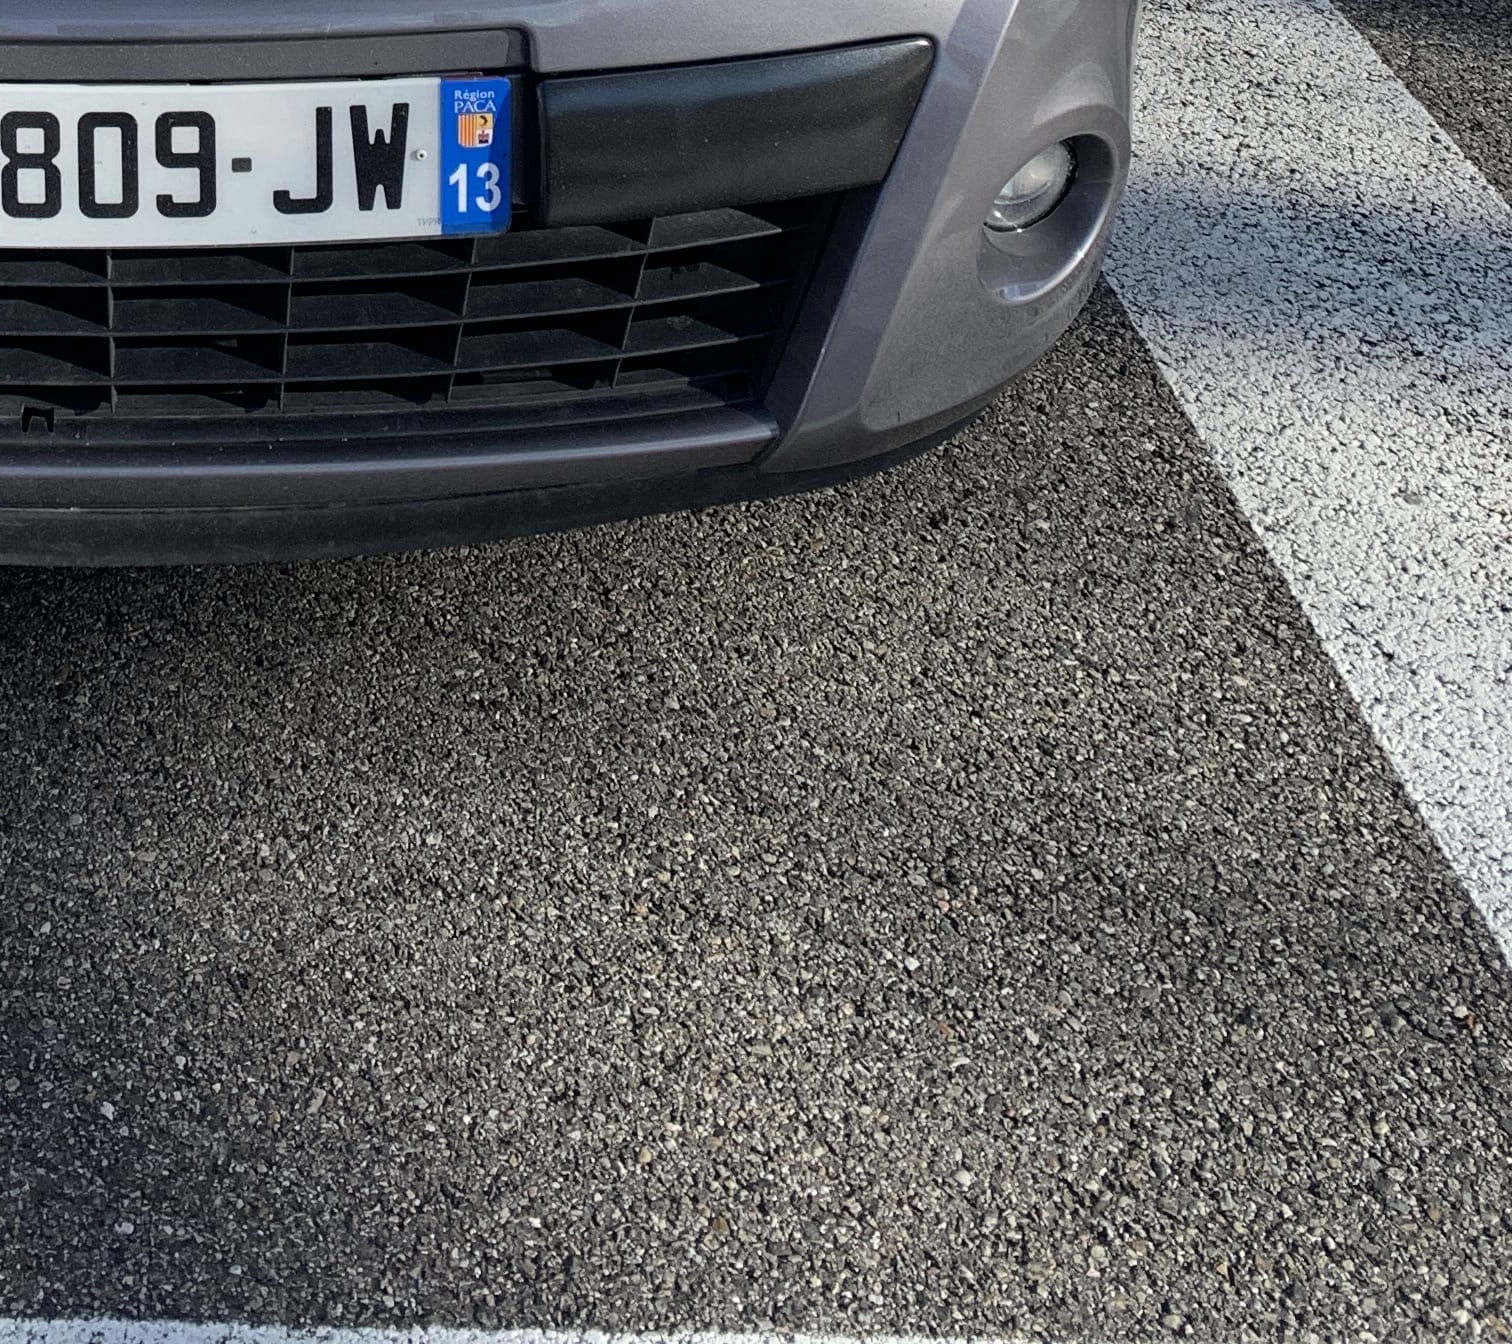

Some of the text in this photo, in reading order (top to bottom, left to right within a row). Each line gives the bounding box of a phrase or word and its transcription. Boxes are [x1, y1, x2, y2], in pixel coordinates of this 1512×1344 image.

[454, 89, 495, 102] Région
[454, 100, 497, 113] PACA
[449, 162, 502, 213] 13
